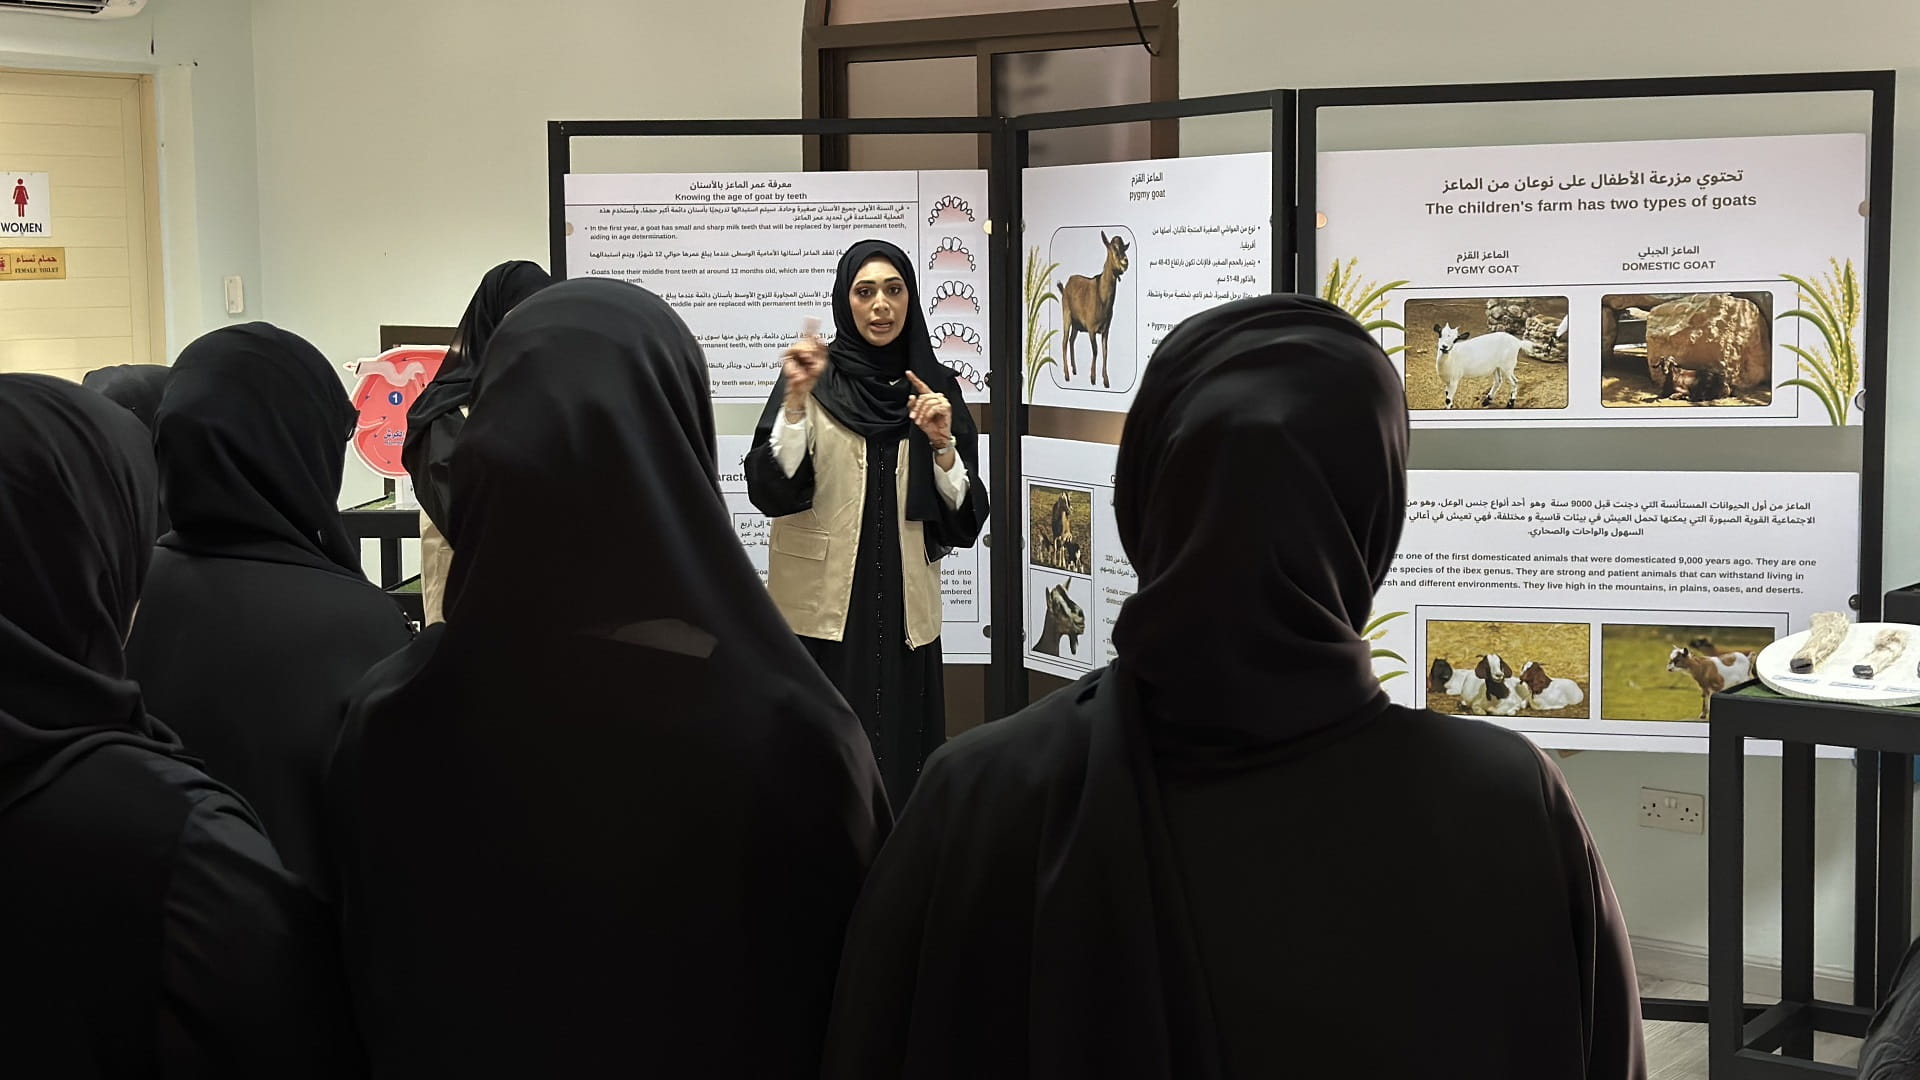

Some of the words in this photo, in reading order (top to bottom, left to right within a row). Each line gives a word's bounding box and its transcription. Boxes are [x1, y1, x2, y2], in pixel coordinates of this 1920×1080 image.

[1132, 174, 1145, 187] القزم
[1146, 172, 1163, 184] الماعز
[1559, 175, 1586, 190] على
[1591, 171, 1644, 189] الأطفال
[1650, 171, 1691, 187] مزرعة
[1697, 170, 1743, 189] تحتوي
[690, 180, 723, 190] بالأسنان
[725, 181, 748, 190] الماعز
[768, 180, 791, 189] معرفة
[1442, 178, 1482, 193] الماعز
[1488, 180, 1509, 192] من
[1515, 176, 1553, 191] نوعان
[675, 194, 710, 202] Knowing
[775, 193, 784, 201] by
[1130, 192, 1150, 201] pygmy
[1152, 190, 1165, 200] goat
[1425, 203, 1453, 214] The
[1459, 201, 1533, 213] children's
[1538, 200, 1572, 211] farm
[1578, 199, 1605, 210] has
[1611, 199, 1638, 209] two
[1643, 198, 1686, 211] types
[1692, 195, 1707, 207] of
[1713, 195, 1756, 209] goats
[1, 223, 42, 232] WOMEN
[1482, 250, 1509, 261] الماعز
[1638, 247, 1668, 260] الجبلي
[1671, 246, 1699, 256] الماعز
[17, 254, 35, 262] نساء
[38, 254, 57, 265] حمام
[1457, 251, 1479, 263] القزم
[1448, 266, 1485, 274] PYGMY
[1488, 265, 1519, 273] GOAT
[1623, 262, 1680, 271] DOMESTIC
[1684, 261, 1716, 269] GOAT
[393, 394, 398, 403] 1
[1466, 500, 1488, 508] جنس
[1491, 497, 1509, 509] أنواع
[1512, 497, 1525, 506] أحد
[1551, 499, 1568, 507] سنة
[1594, 500, 1610, 509] قبل
[1641, 501, 1658, 511] التي
[1661, 499, 1707, 508] المستأنسة
[1710, 502, 1749, 511] الحيوانات
[1752, 500, 1766, 511] أول
[1785, 502, 1810, 511] الماعز
[1409, 510, 1429, 522] أعالي
[1432, 511, 1444, 523] في
[1446, 512, 1471, 521] تعيش
[1474, 512, 1491, 523] فهي
[1535, 512, 1560, 522] قاسية
[1563, 514, 1586, 523] بيئات
[1589, 514, 1601, 524] في
[1604, 514, 1632, 523] العيش
[1634, 514, 1657, 523] تحمل
[1661, 515, 1686, 524] يمكنها
[1689, 515, 1706, 525] التي
[1709, 515, 1741, 524] الصبورة
[1745, 515, 1769, 525] القوية
[1772, 515, 1815, 525] الاجتماعية
[1572, 528, 1608, 536] والواحات
[1611, 528, 1643, 537] السهول
[1679, 557, 1703, 565] 9,000
[1756, 558, 1779, 567] They
[1400, 566, 1433, 574] species
[1516, 568, 1537, 576] They
[1557, 569, 1585, 577] strong
[1608, 569, 1638, 578] patient
[1767, 572, 1792, 581] living
[1523, 582, 1545, 590] They
[1566, 582, 1585, 591] high
[1616, 584, 1666, 592] mountains,
[1680, 584, 1710, 593] plains,
